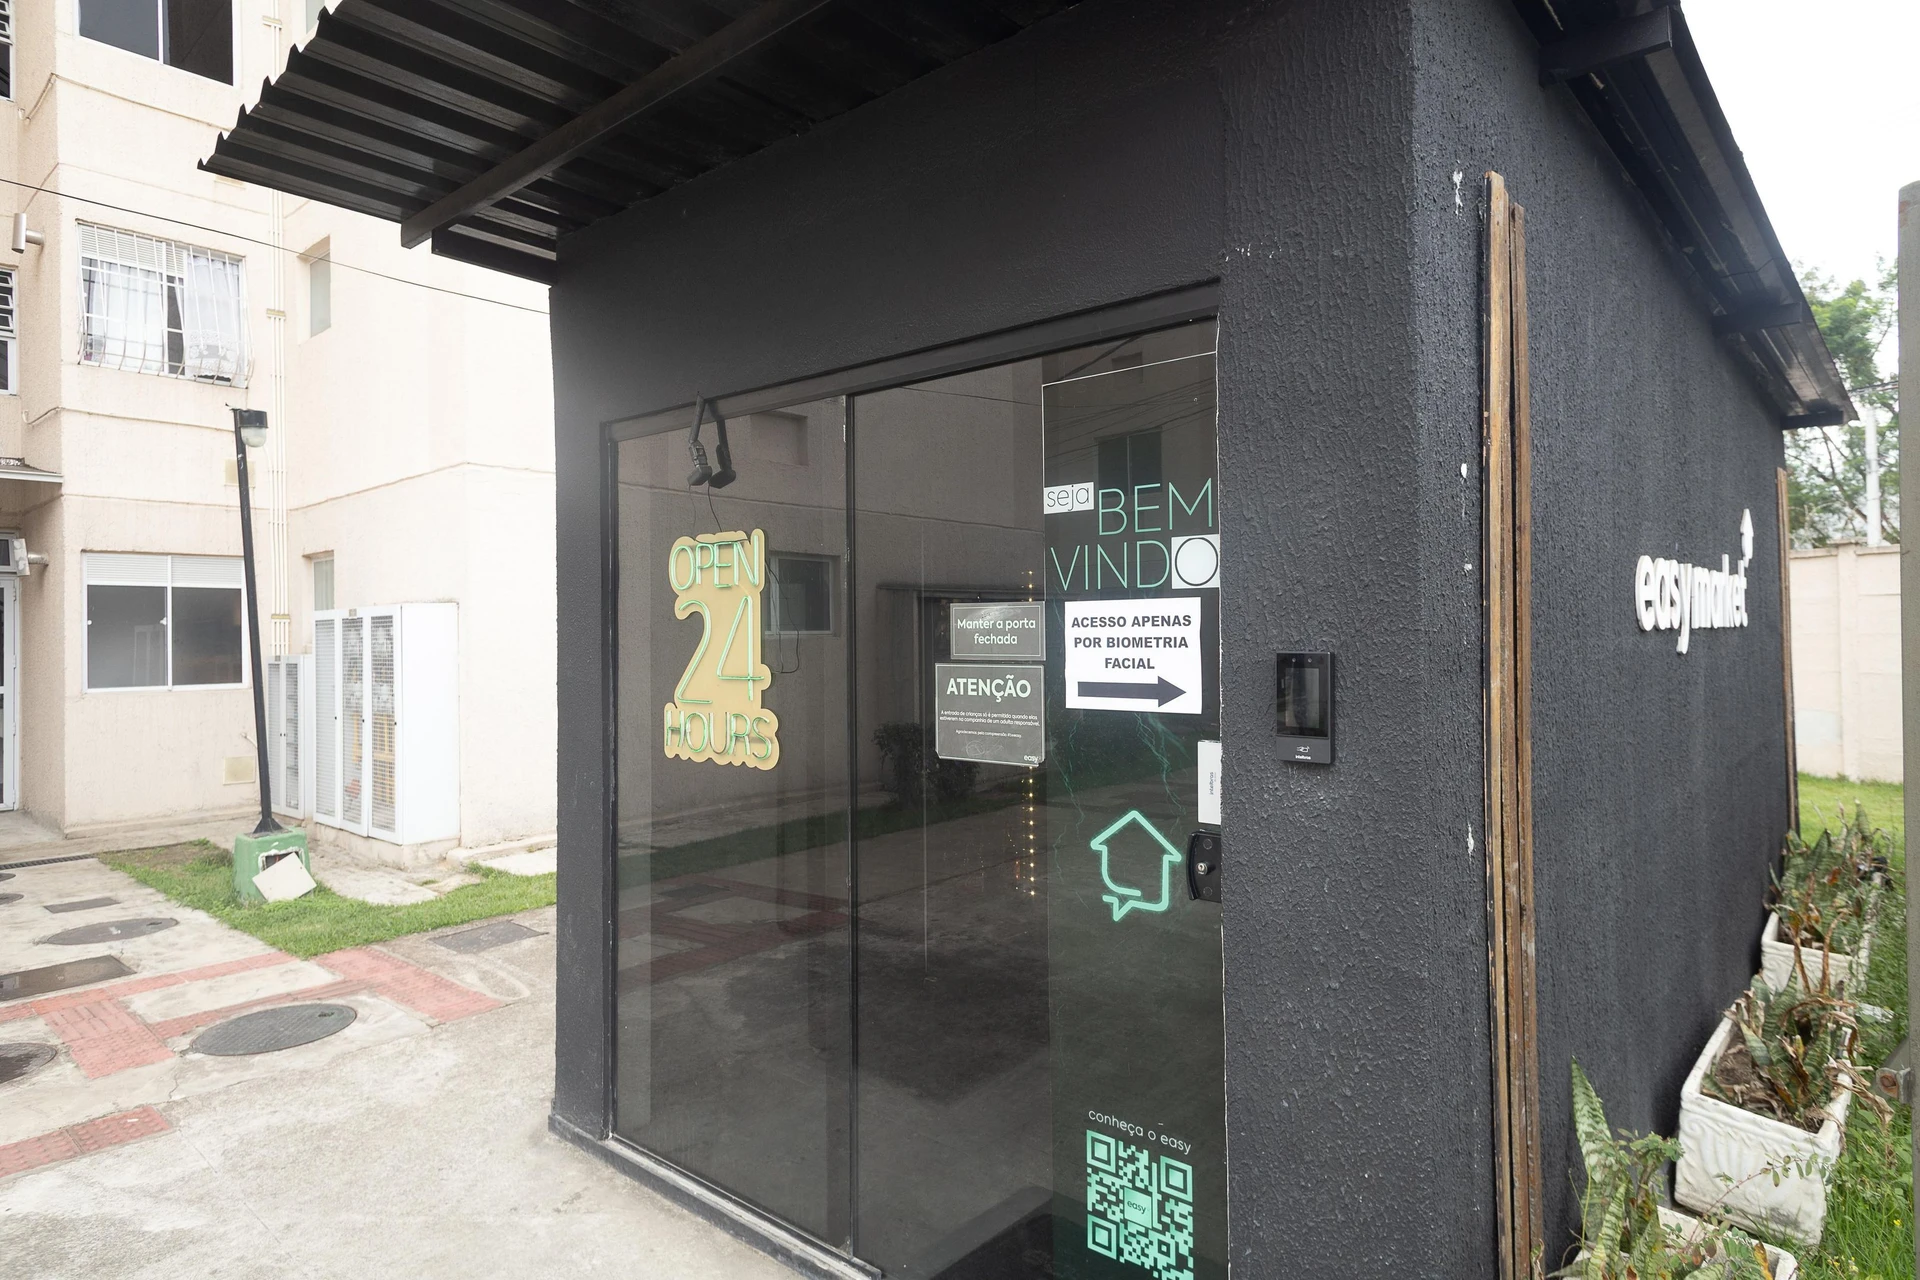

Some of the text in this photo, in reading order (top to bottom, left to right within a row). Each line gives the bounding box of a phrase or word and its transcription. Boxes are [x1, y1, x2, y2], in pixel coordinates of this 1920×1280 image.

[1046, 478, 1212, 536] seja BEM
[669, 534, 759, 590] OPEN
[1050, 537, 1219, 591] VINDO
[957, 617, 1036, 631] Manter a porta
[1071, 615, 1192, 628] ACESSO APENAS
[974, 633, 1018, 645] fechada
[1074, 636, 1189, 648] POR BIOMETRIA
[676, 596, 765, 704] 24
[1105, 657, 1155, 669] FACIAL
[946, 674, 1031, 702] ATENÇÃO
[665, 710, 772, 760] HOURS
[1024, 755, 1038, 764] easy
[1088, 1110, 1192, 1155] conheça o easy
[1126, 1200, 1146, 1214] easy
